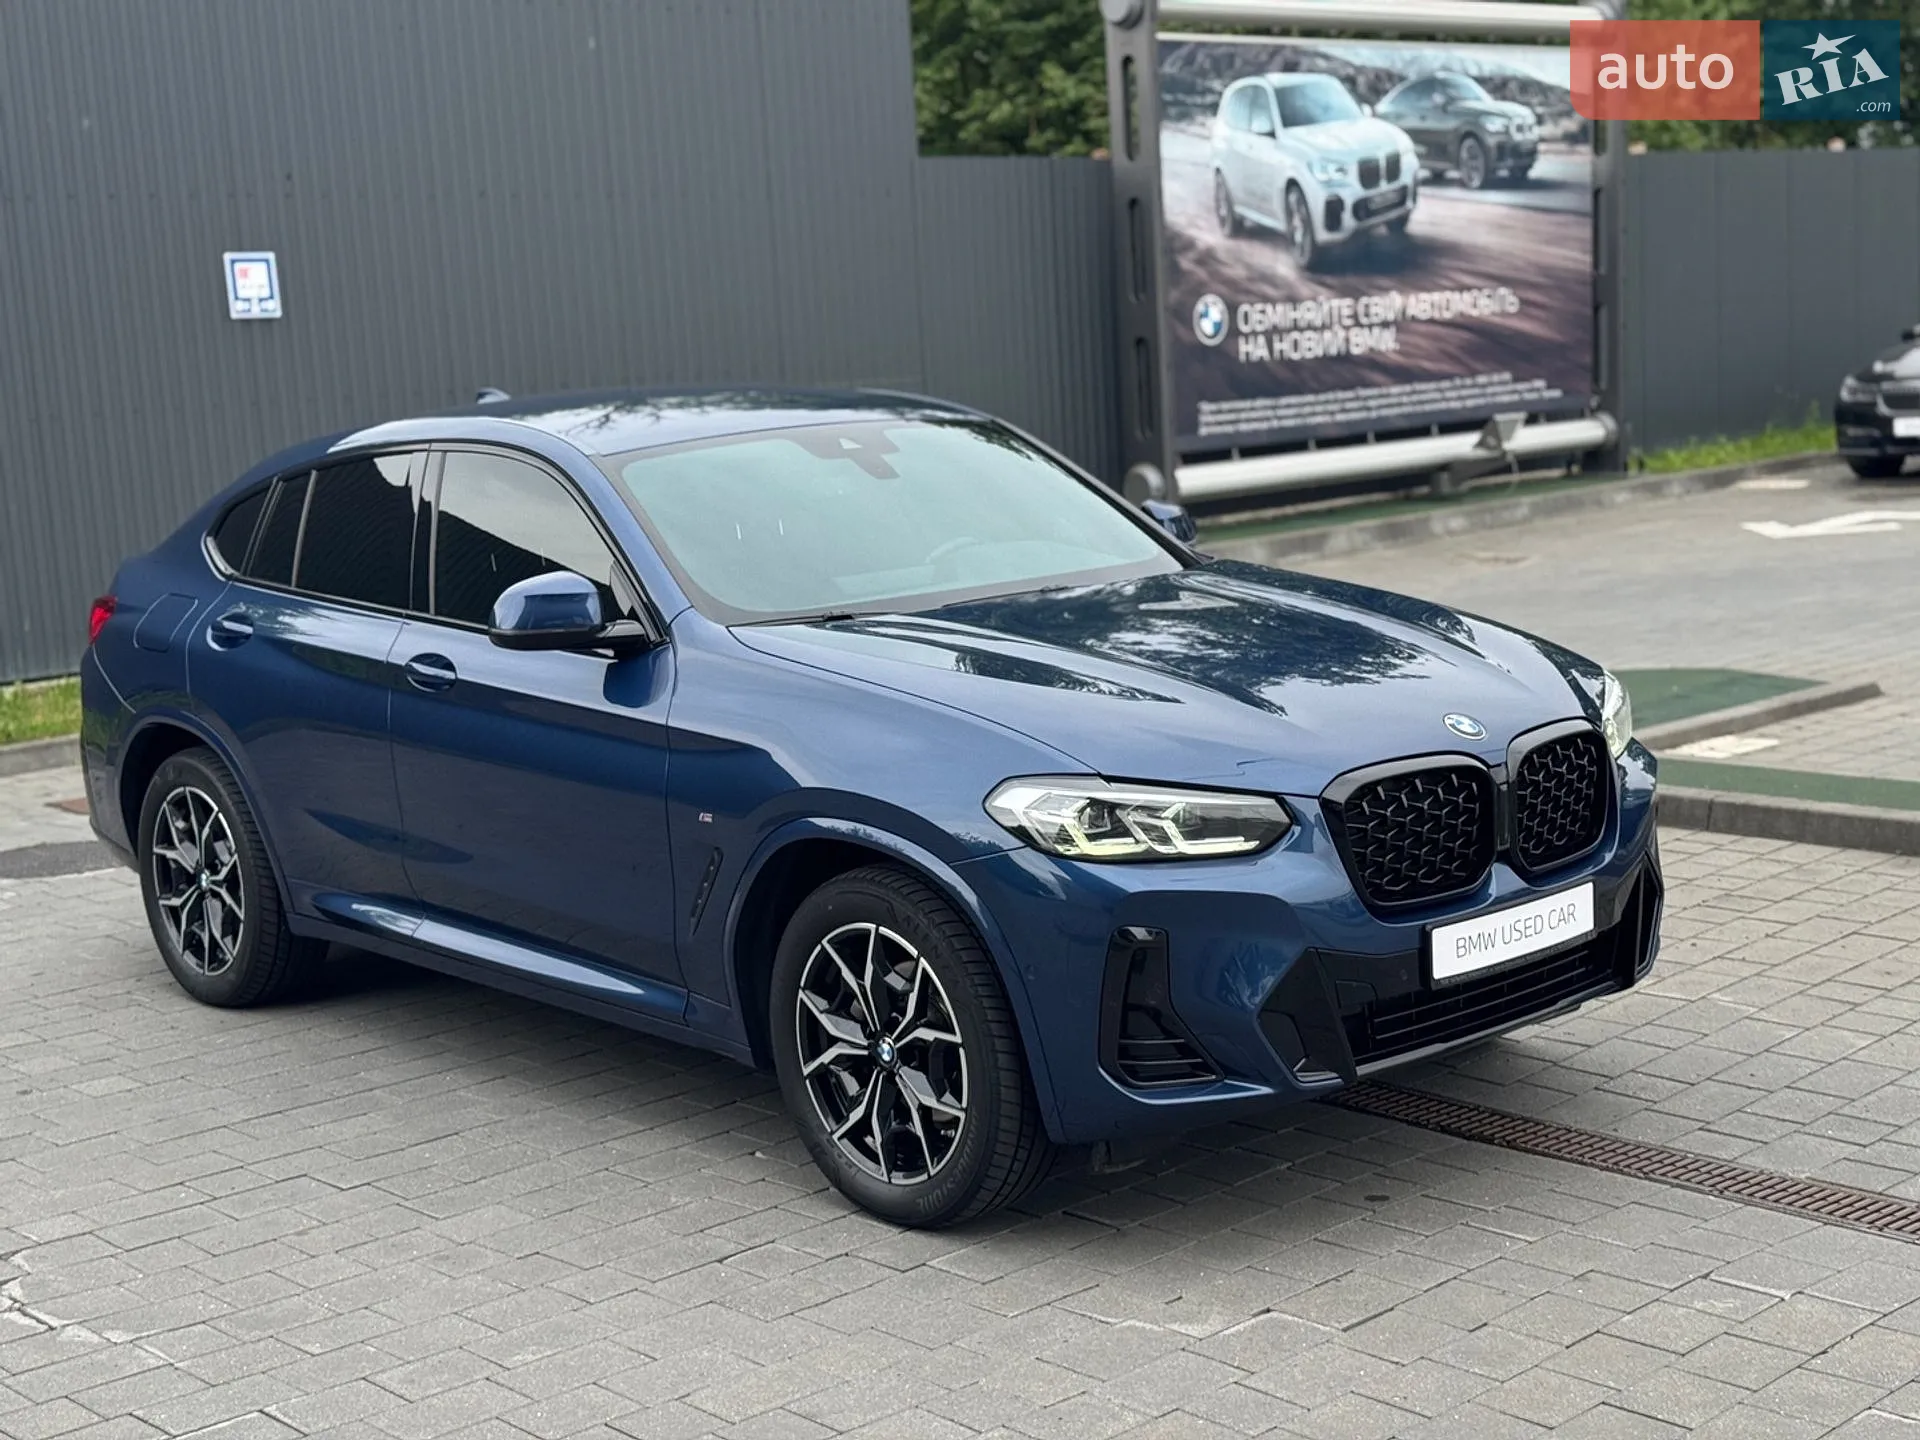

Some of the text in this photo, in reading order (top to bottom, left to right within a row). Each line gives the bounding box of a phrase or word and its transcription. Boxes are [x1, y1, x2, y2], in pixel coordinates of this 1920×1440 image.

[1237, 287, 1520, 333] ОБМІНЯЙТЕ СВІЙ АВТОМОБІЛЬ
[1238, 333, 1270, 363] НА
[1272, 325, 1347, 360] НОВИЙ
[1456, 903, 1577, 959] BMW USED CAR
